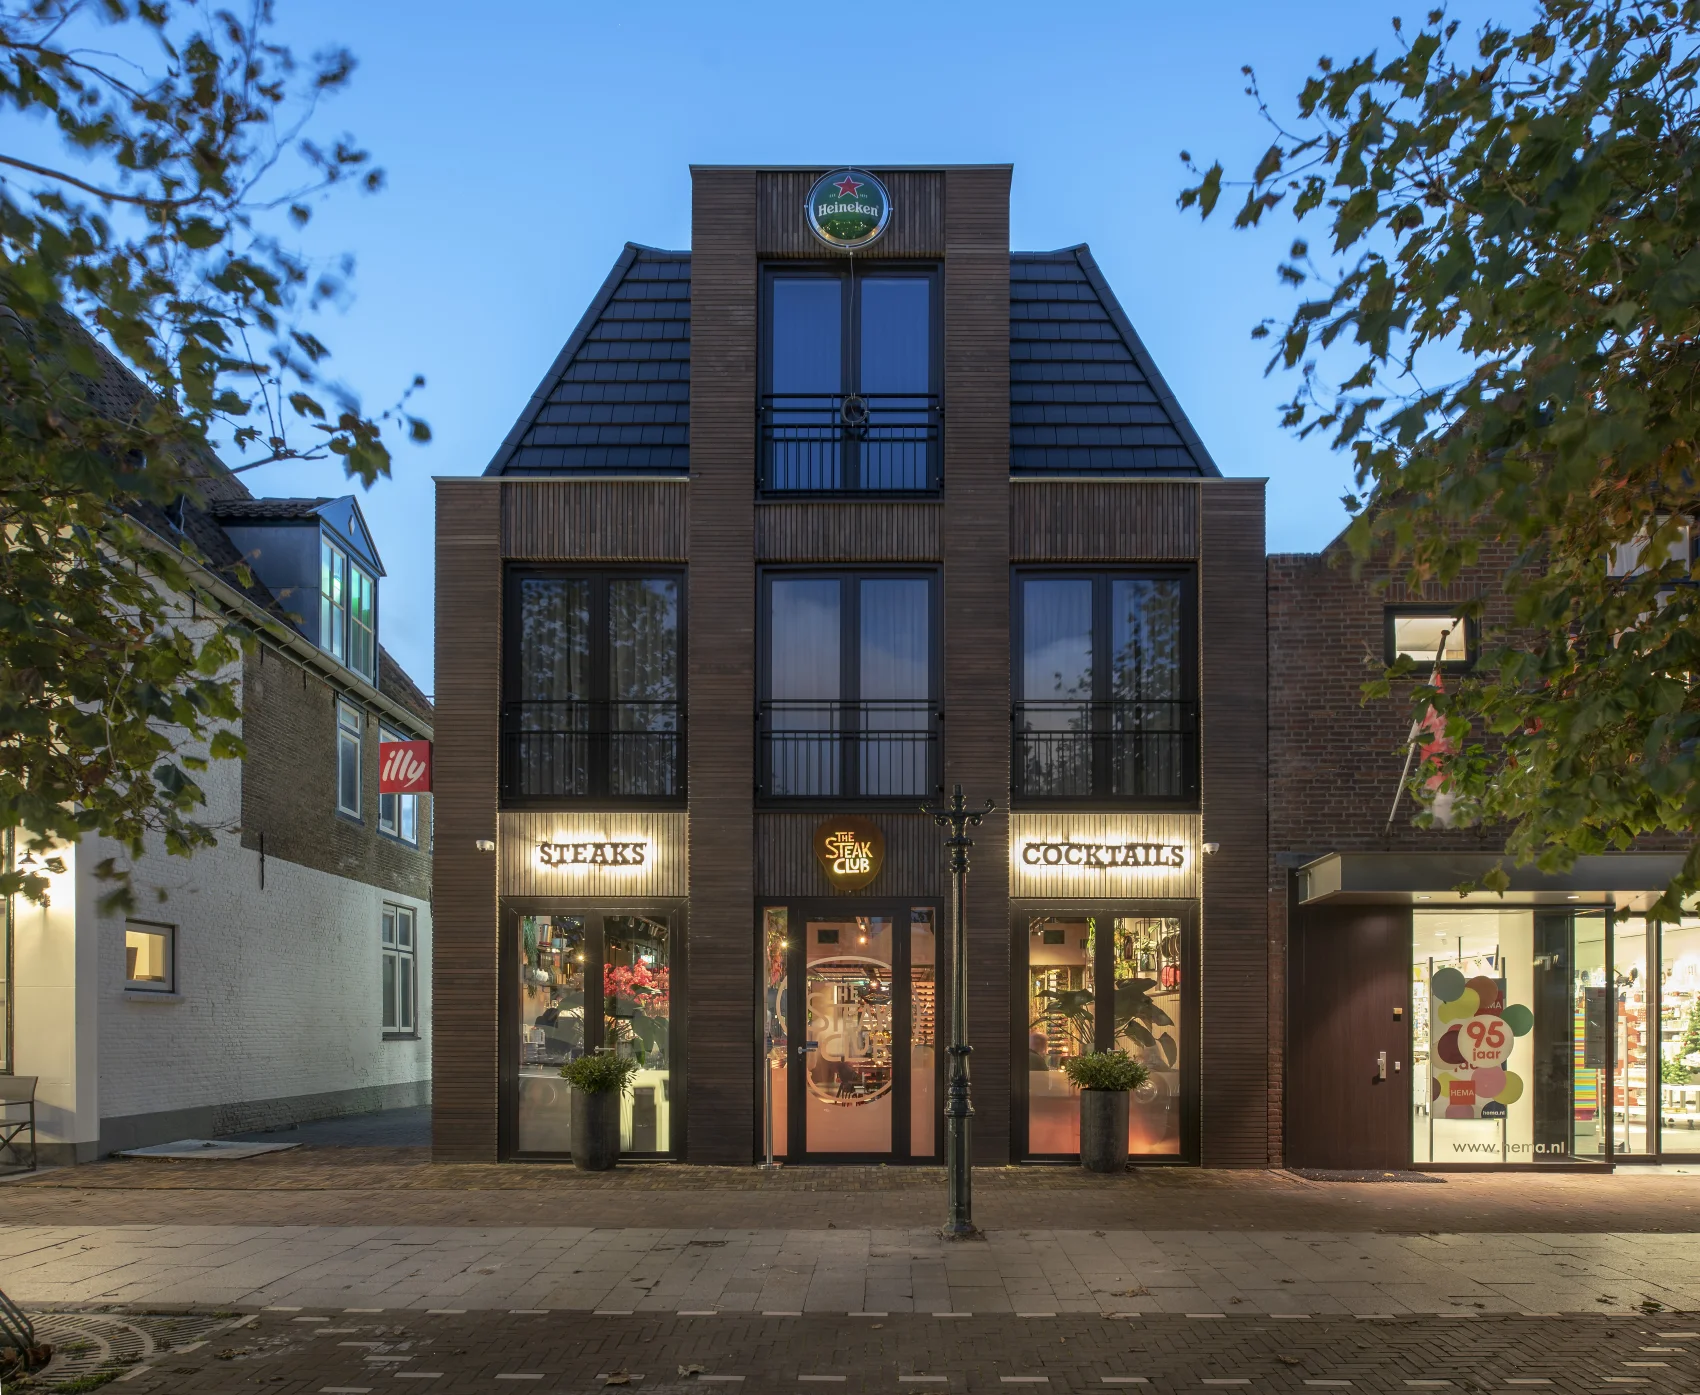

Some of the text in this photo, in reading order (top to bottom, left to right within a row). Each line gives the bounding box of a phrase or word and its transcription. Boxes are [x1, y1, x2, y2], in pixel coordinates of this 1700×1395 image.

[818, 201, 878, 217] Heineken
[382, 749, 426, 788] illy
[825, 837, 873, 858] STEAK
[835, 832, 855, 842] THE
[540, 843, 647, 865] STEAKS
[1022, 844, 1185, 867] COCKTAILS
[833, 858, 870, 874] CLUB
[825, 982, 861, 1004] THE
[1466, 1021, 1505, 1048] 95
[821, 1033, 889, 1063] CLUB
[1472, 1048, 1501, 1062] jaar
[1450, 1089, 1474, 1097] HEMA
[1452, 1141, 1565, 1154] www.hema.nl
